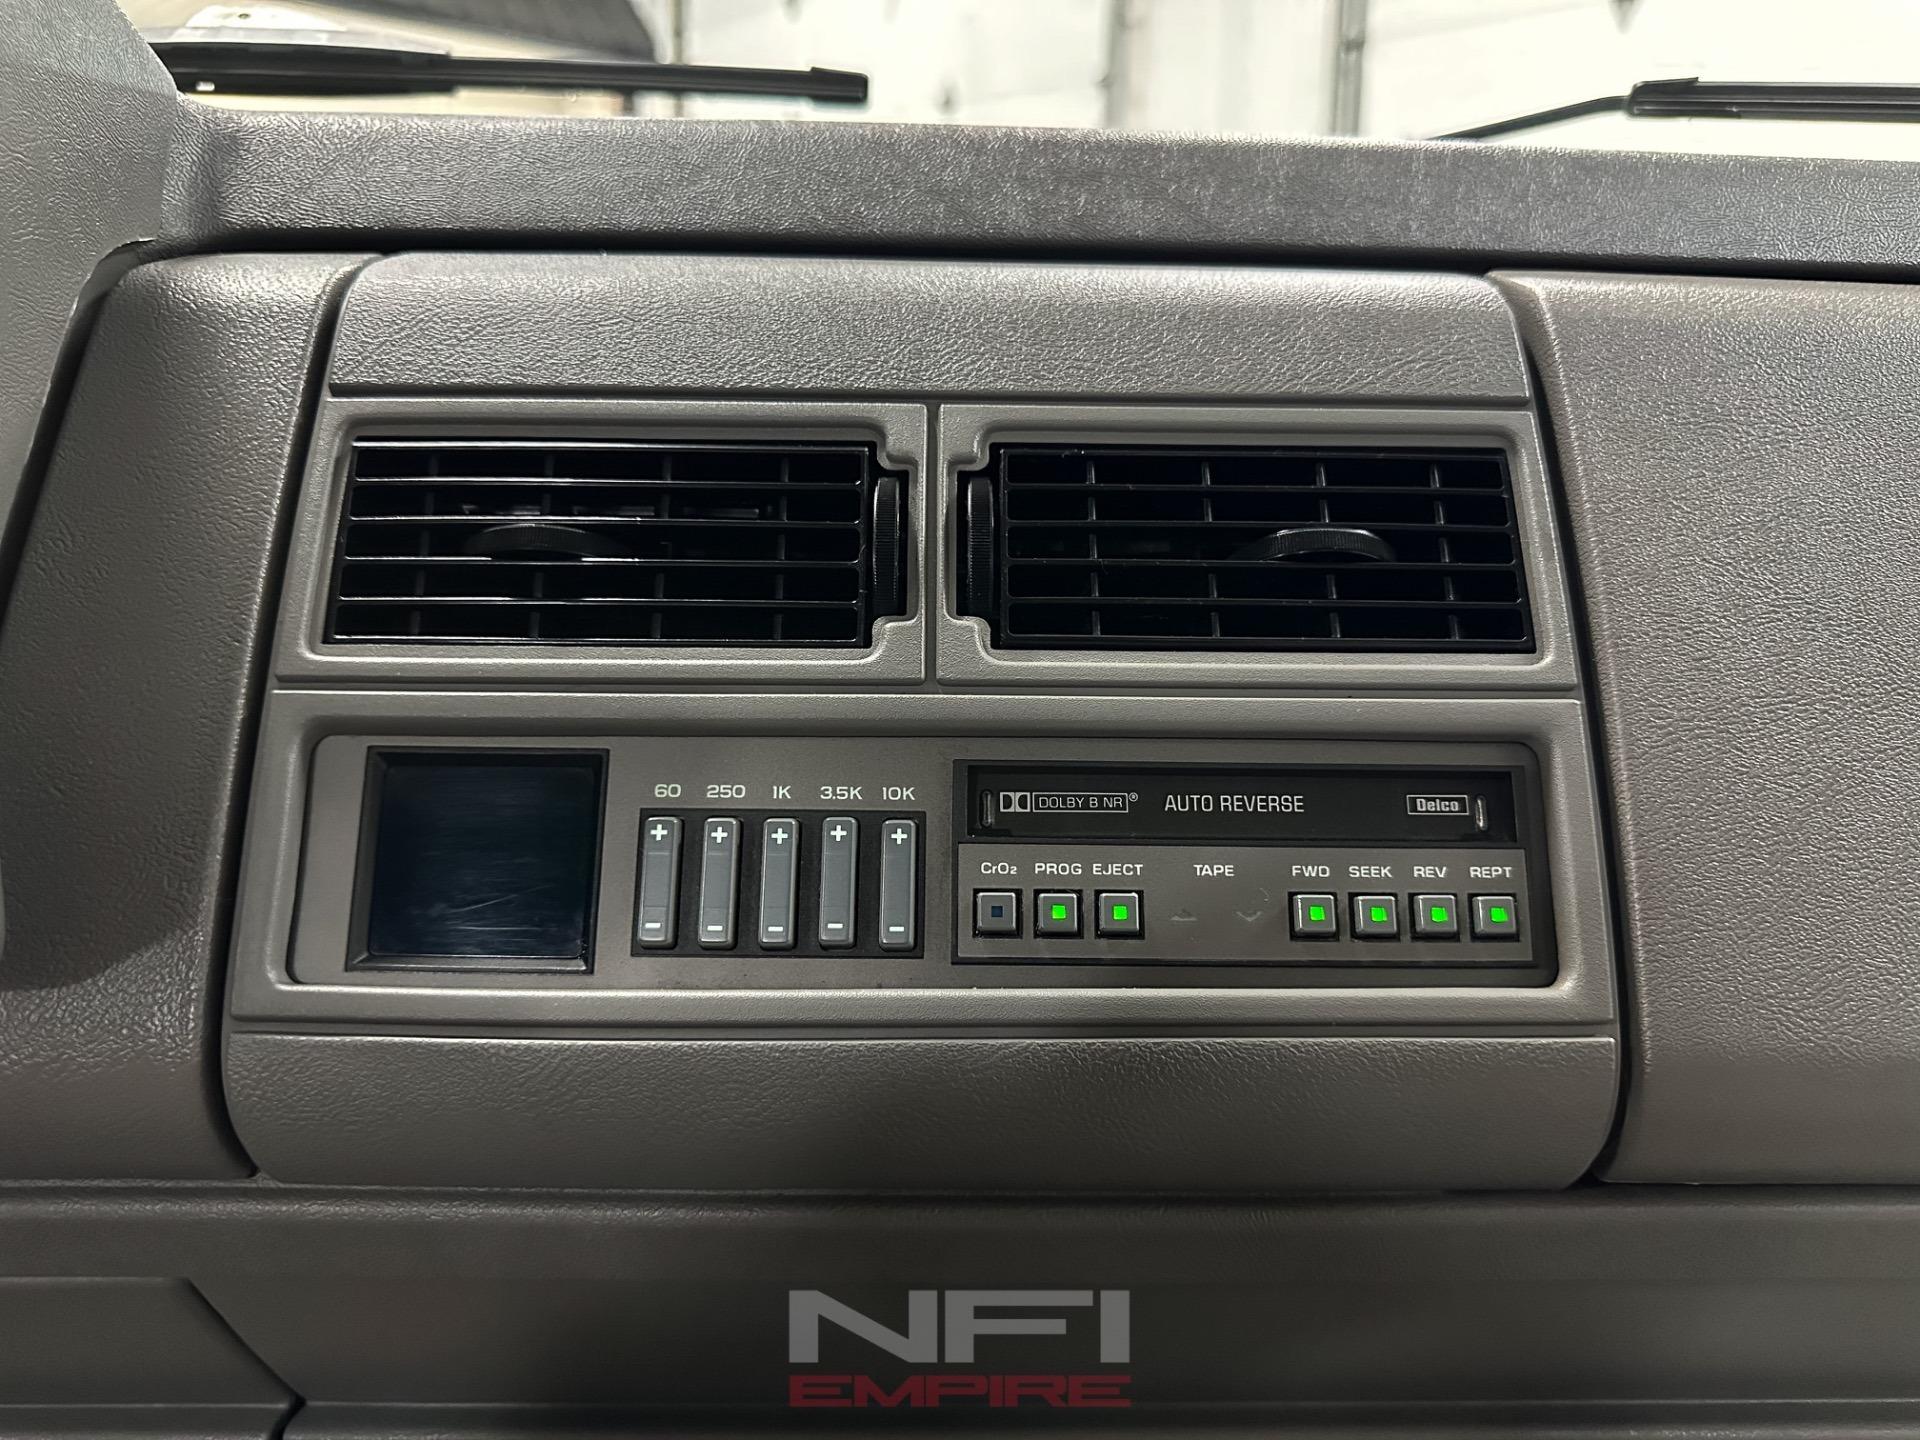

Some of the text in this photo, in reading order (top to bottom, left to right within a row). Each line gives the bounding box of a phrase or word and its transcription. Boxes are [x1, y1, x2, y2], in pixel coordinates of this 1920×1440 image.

[653, 783, 682, 799] 60
[706, 784, 746, 799] 250
[820, 786, 863, 800] 3.5K
[882, 787, 915, 801] 10K
[1038, 796, 1085, 809] DOLBY
[1089, 797, 1099, 809] B
[1164, 794, 1305, 813] AUTO REVERSE
[1416, 798, 1460, 812] Delco
[1034, 863, 1082, 876] PROG
[1092, 863, 1143, 876] EJECT
[1193, 864, 1234, 877] TAPE
[1291, 865, 1330, 878] FWD
[1348, 866, 1393, 878] SEEK
[1413, 866, 1447, 878] REV
[1469, 866, 1512, 879] REPT
